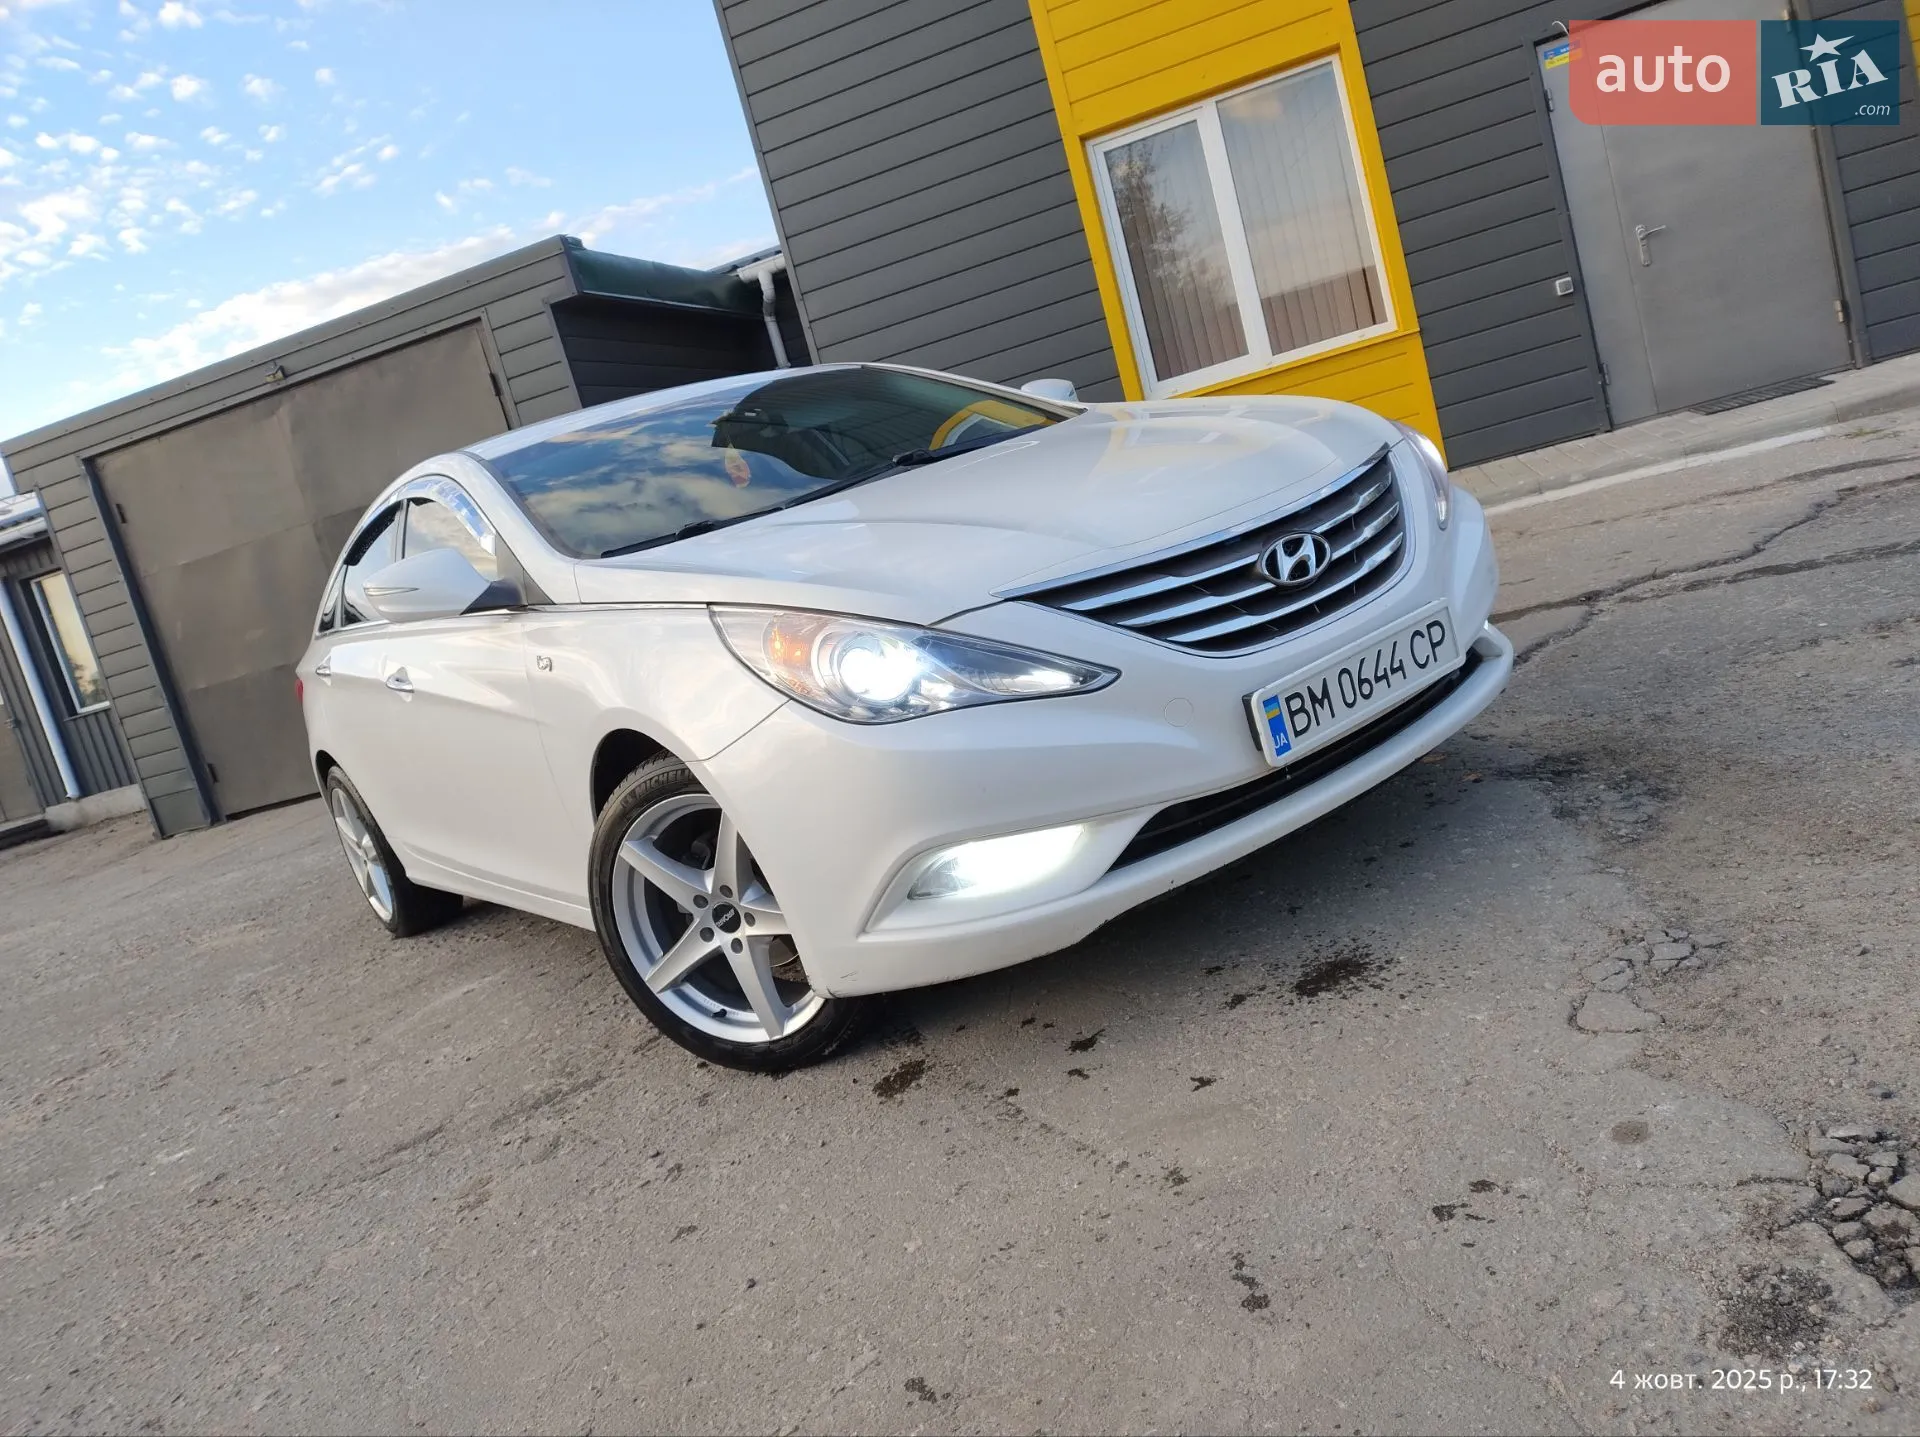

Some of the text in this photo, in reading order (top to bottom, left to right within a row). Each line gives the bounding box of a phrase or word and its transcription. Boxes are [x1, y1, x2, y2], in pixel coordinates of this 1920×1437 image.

[1285, 619, 1446, 738] BM 0644 CP
